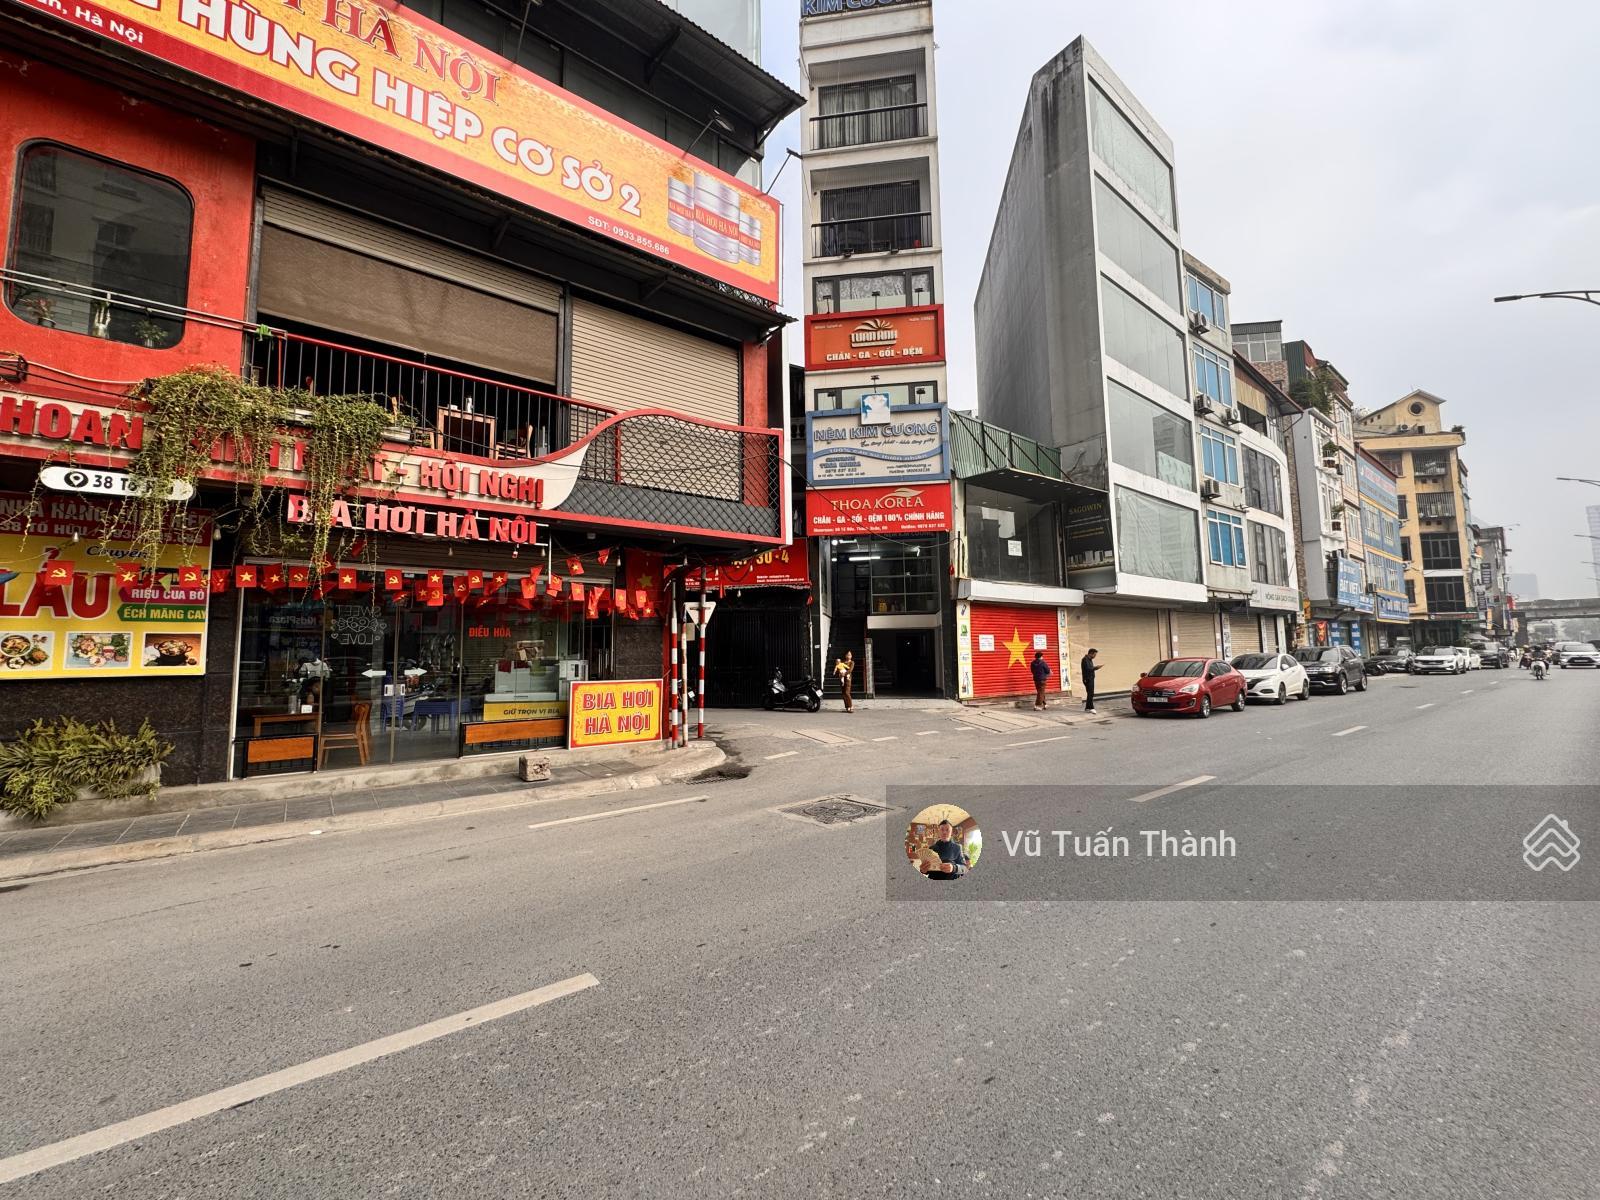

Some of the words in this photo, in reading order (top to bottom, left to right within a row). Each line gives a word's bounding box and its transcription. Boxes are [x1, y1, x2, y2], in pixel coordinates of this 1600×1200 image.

[75, 5, 104, 28] Hà
[110, 19, 144, 44] Nội
[322, 0, 402, 59] HÀ
[414, 36, 500, 106] NỘI
[178, 0, 360, 97] HÙNG
[372, 67, 484, 144] HIỆP
[491, 126, 556, 176] CƠ
[561, 154, 615, 205] SỞ
[619, 183, 642, 218] 2
[814, 427, 847, 445] NỆM
[850, 425, 879, 440] KIM
[881, 422, 939, 437] CƯƠNG
[92, 474, 114, 489] 38
[420, 459, 471, 498] HỘI
[479, 469, 545, 510] NGHỊ
[287, 493, 353, 528] BA
[365, 502, 426, 534] HƠI
[437, 508, 480, 540] HÀ
[830, 499, 871, 511] THOA
[872, 496, 925, 511] KOREA
[582, 691, 616, 711] BIA
[621, 689, 654, 709] HƠI
[584, 711, 612, 736] HÀ
[617, 710, 651, 735] NỘI
